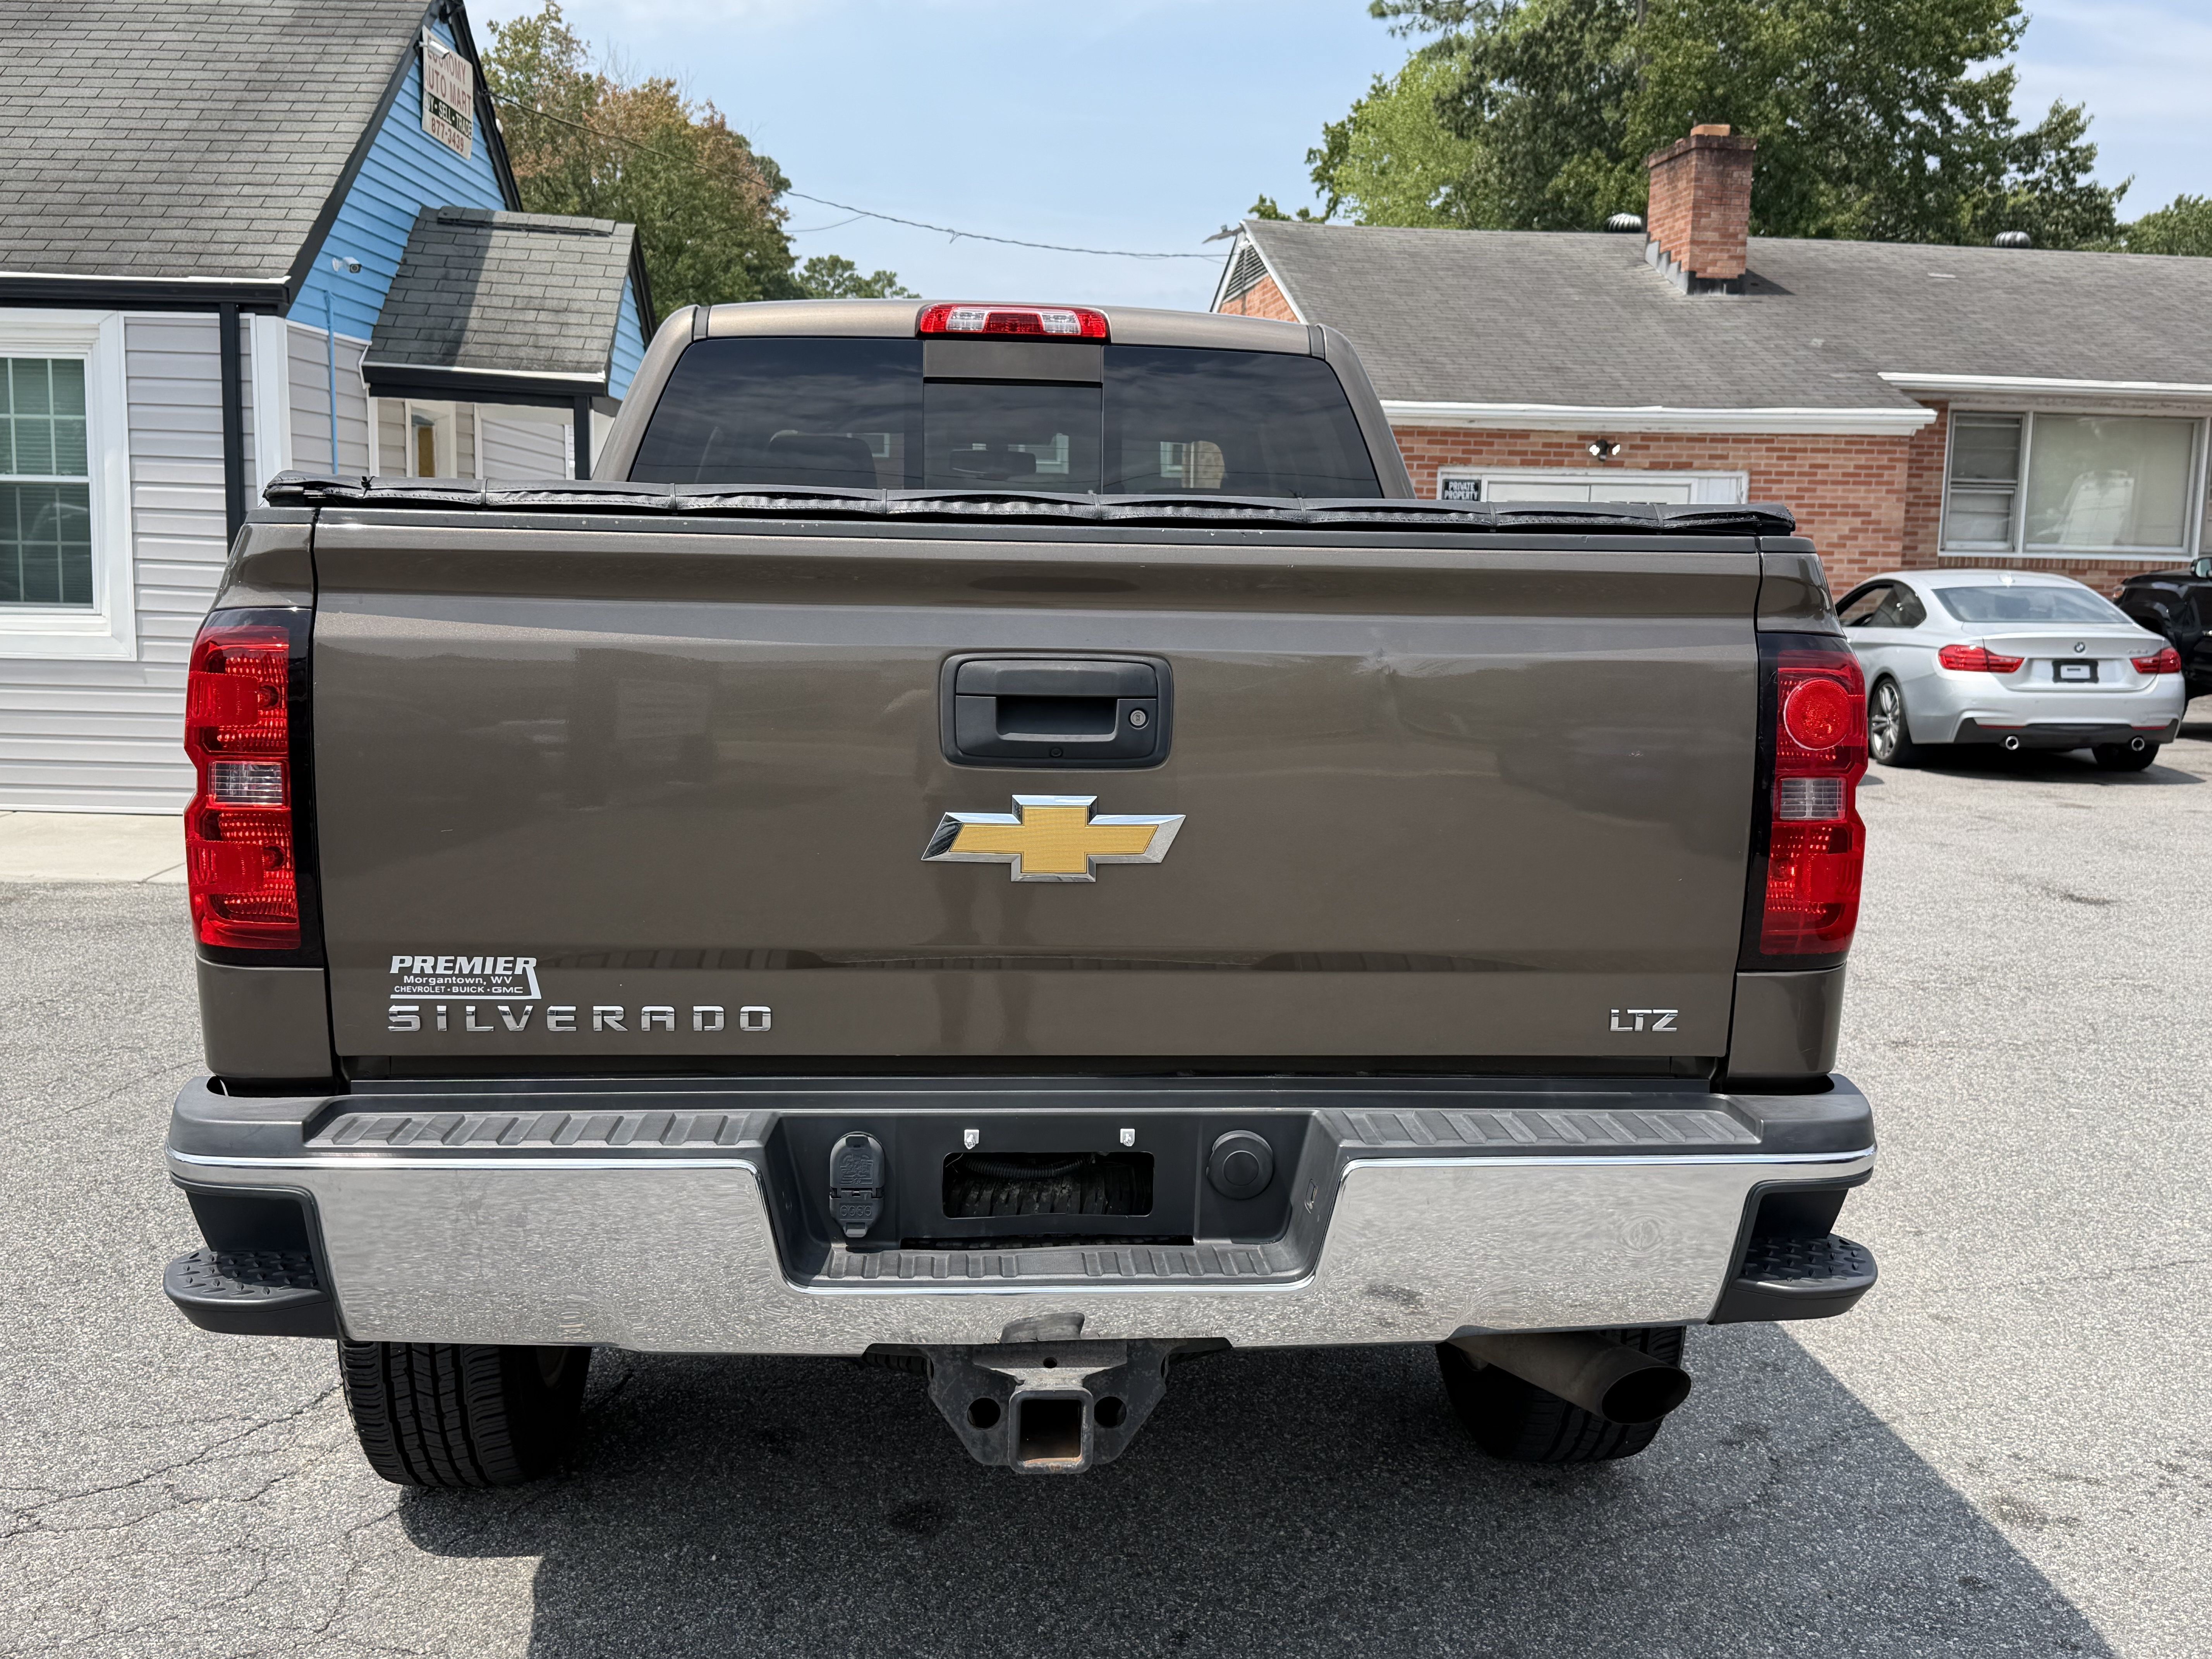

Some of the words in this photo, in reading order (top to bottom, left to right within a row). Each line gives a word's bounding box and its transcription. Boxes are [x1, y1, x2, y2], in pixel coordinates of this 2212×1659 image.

[450, 81, 471, 117] MART
[439, 101, 452, 124] SELL
[456, 113, 472, 138] TRADE
[432, 117, 464, 152] 877-3439
[1444, 490, 1478, 500] PROPERTY
[1449, 481, 1475, 491] PRIVATE
[390, 955, 537, 975] PREMIER
[404, 975, 486, 985] Morgantown,
[491, 976, 512, 984] WV
[388, 1005, 771, 1032] SILVERADO
[1610, 1009, 1678, 1032] LTZ
